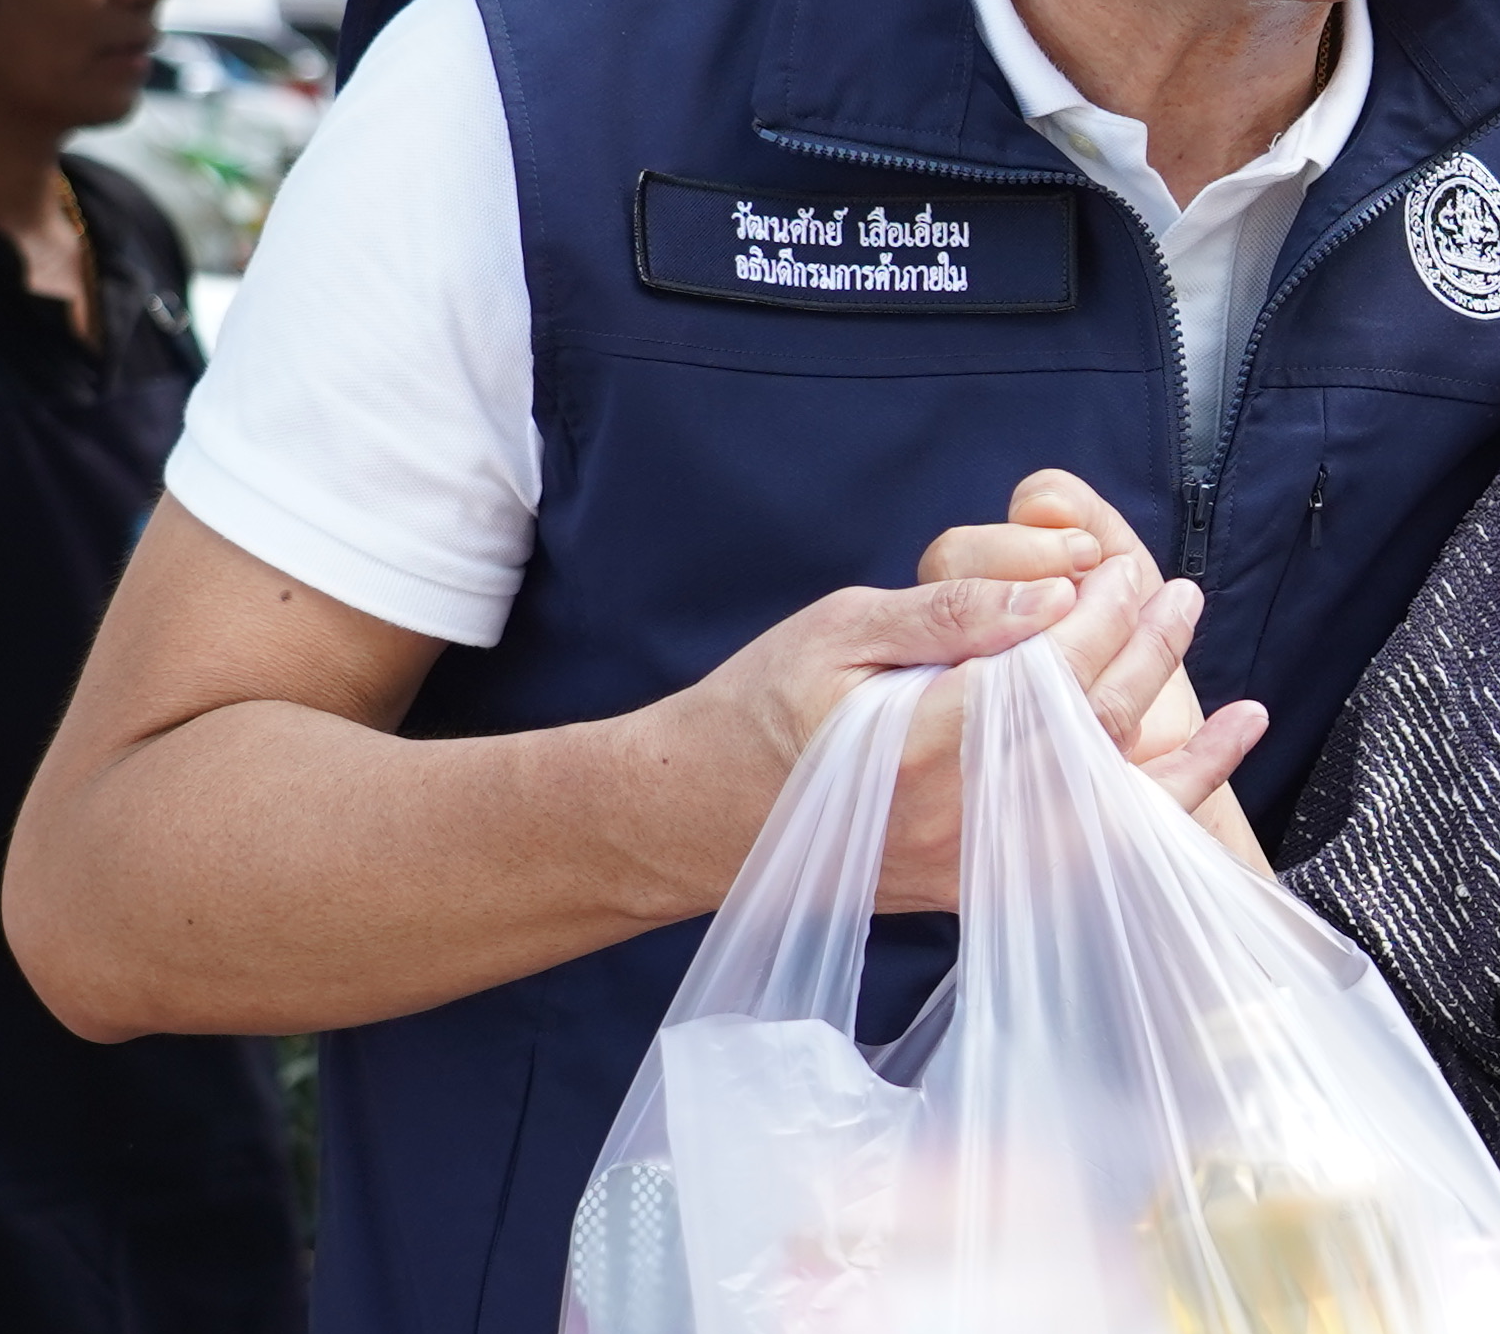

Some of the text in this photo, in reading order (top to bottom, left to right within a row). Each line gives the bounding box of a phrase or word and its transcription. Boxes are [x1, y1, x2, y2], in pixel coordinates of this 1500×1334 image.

[858, 202, 971, 249] เสือเอี่ยม
[734, 247, 969, 294] อธิบดีกรมการค้าภายใน
